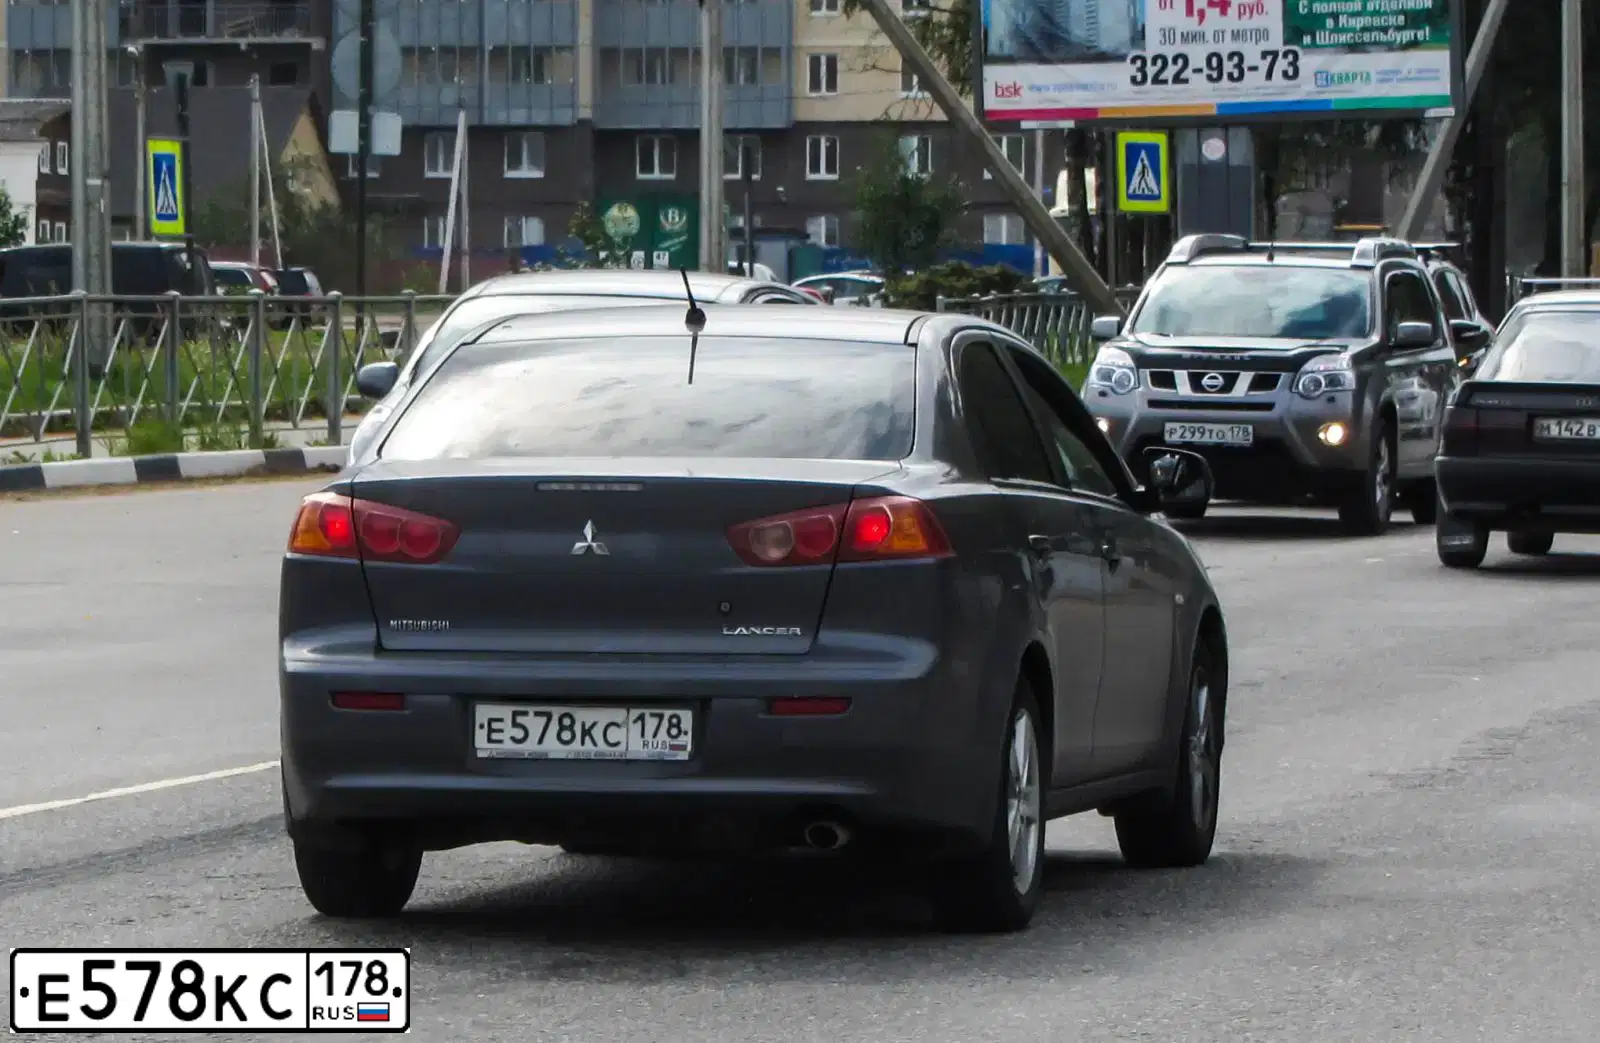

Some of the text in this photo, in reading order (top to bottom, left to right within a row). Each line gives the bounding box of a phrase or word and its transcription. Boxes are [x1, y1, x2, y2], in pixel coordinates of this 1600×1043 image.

[1238, 1, 1269, 20] руб.
[1339, 14, 1405, 30] Кировске
[1159, 27, 1269, 45] 30 мин. от метро
[1130, 49, 1300, 86] 322-93-73
[995, 80, 1022, 98] bsk
[1540, 419, 1600, 437] М142В
[390, 620, 450, 630] MITSUBISHI
[723, 627, 801, 635] LANCER
[487, 710, 682, 747] Е578КС 178
[642, 740, 668, 750] RUS
